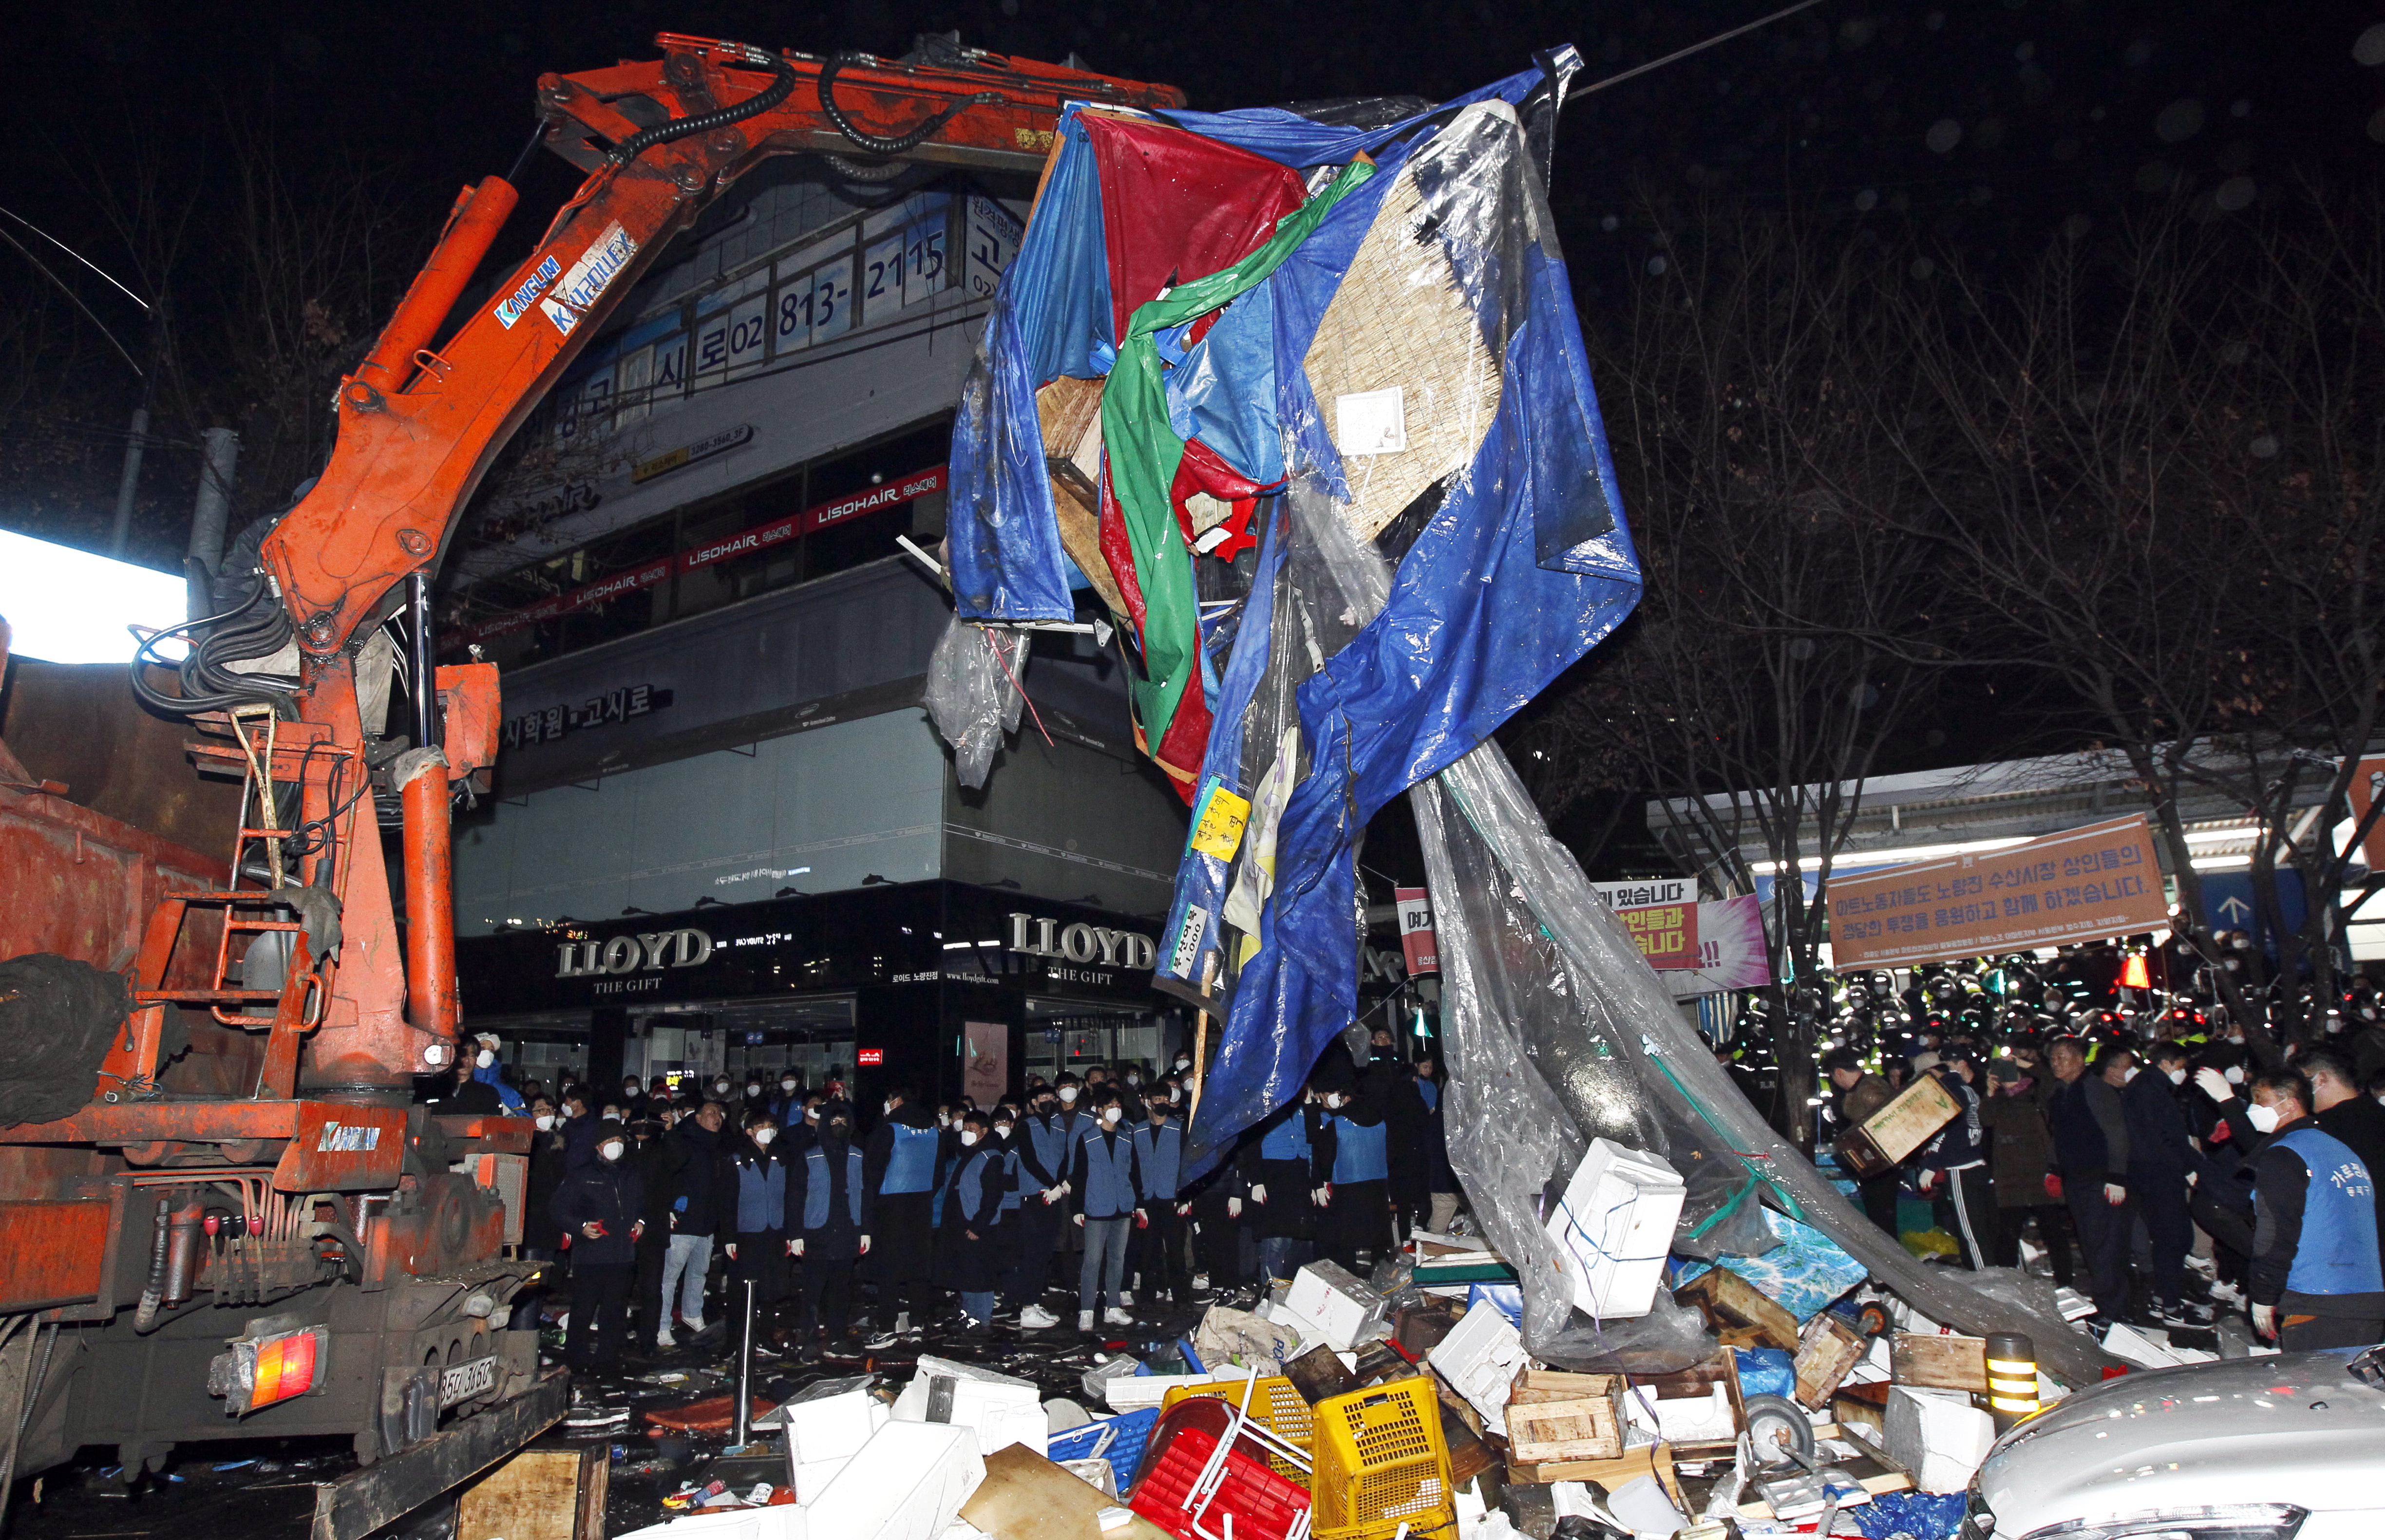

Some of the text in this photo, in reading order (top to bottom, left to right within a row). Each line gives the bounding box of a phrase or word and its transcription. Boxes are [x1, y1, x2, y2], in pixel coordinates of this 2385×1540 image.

[495, 256, 561, 329] KANGLIM
[731, 316, 763, 355] 02
[779, 282, 848, 336] 813-
[868, 231, 944, 299] 2115
[903, 476, 937, 496] 리소헤어
[762, 524, 791, 542] 리소헤어
[584, 684, 652, 728] 고시로
[1617, 883, 1684, 907] 있습니다
[1836, 844, 2143, 916] 마트노동자들도 노량진 수산시장 상인들의
[1888, 912, 1929, 934] 투쟁을
[1935, 901, 1998, 927] 응원하고
[2003, 894, 2039, 916] 함께
[556, 928, 711, 977] LLOYD
[1009, 913, 1157, 970] LLOYD
[1185, 923, 1201, 963] 1,000
[594, 977, 662, 994] THE GIFT
[913, 972, 938, 981] 노량진점
[946, 973, 999, 984] www.lloydgift.com
[1048, 966, 1113, 985] THE GIFT
